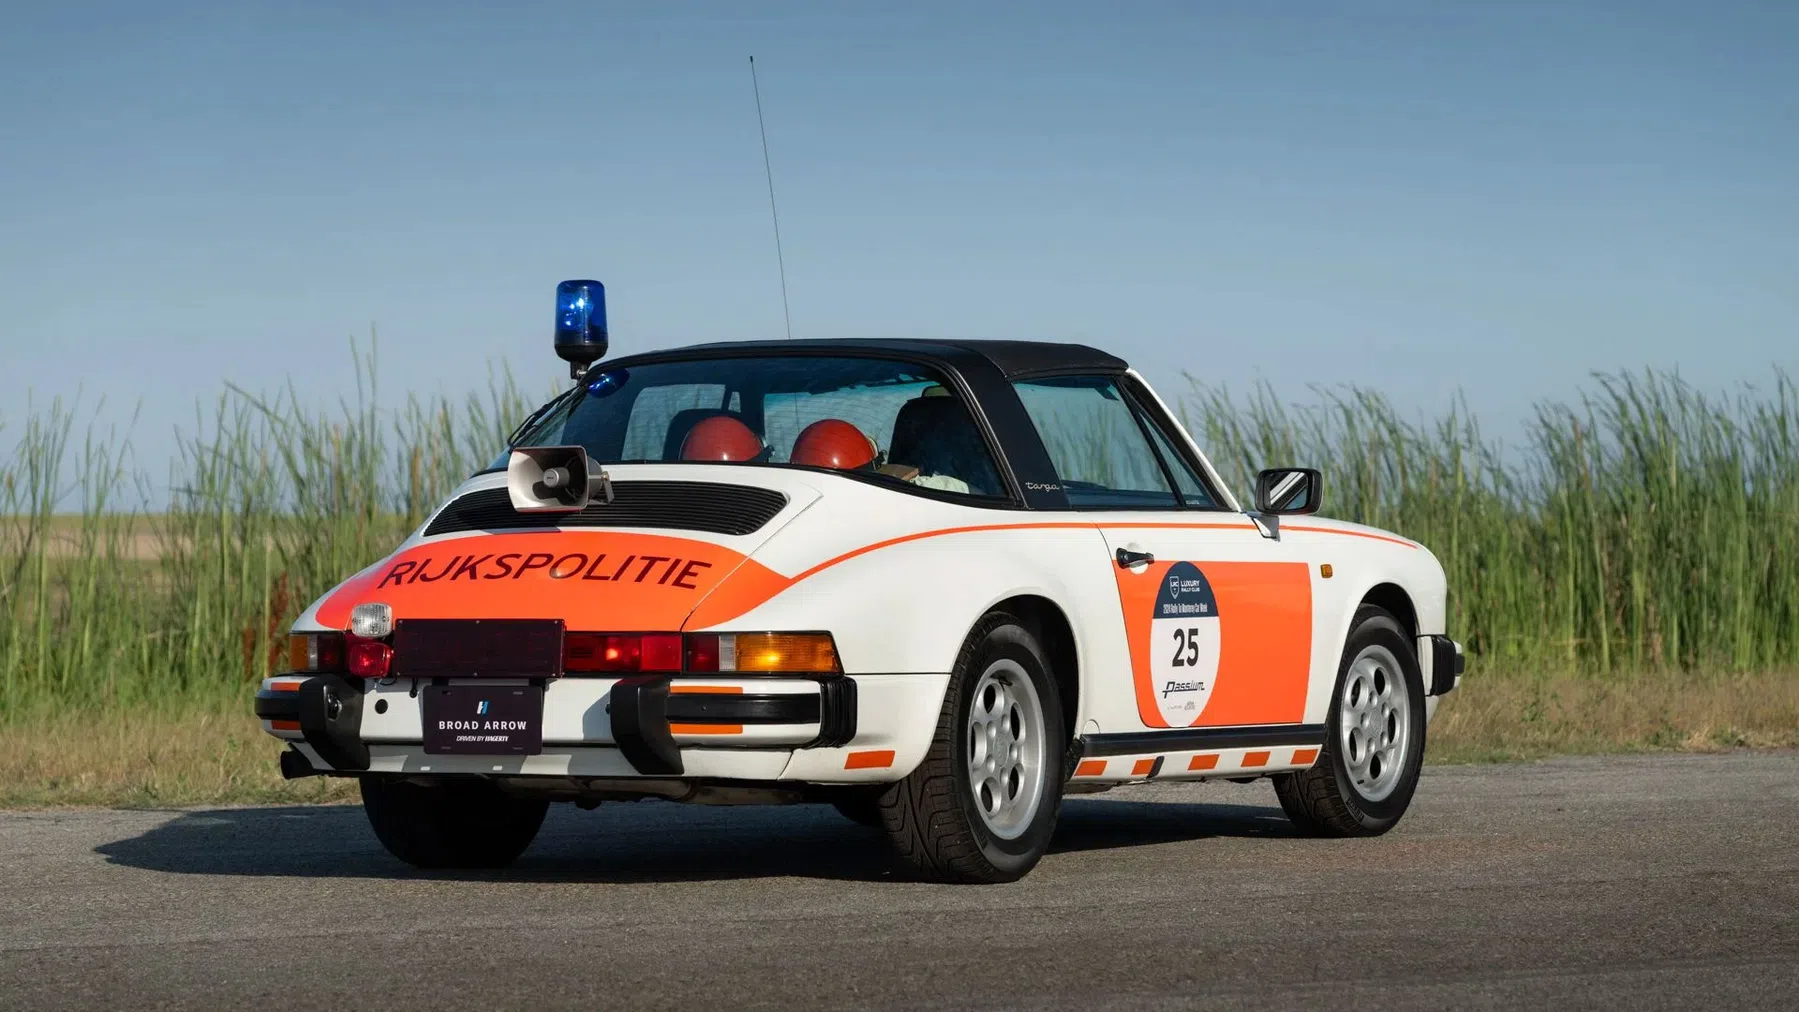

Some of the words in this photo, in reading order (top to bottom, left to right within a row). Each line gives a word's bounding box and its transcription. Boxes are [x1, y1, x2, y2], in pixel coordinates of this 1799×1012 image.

[1025, 482, 1060, 492] targa
[377, 553, 712, 589] RIJKSPOLITIE
[1172, 628, 1199, 667] 25
[438, 721, 479, 730] BROAD
[484, 721, 527, 730] ARROW
